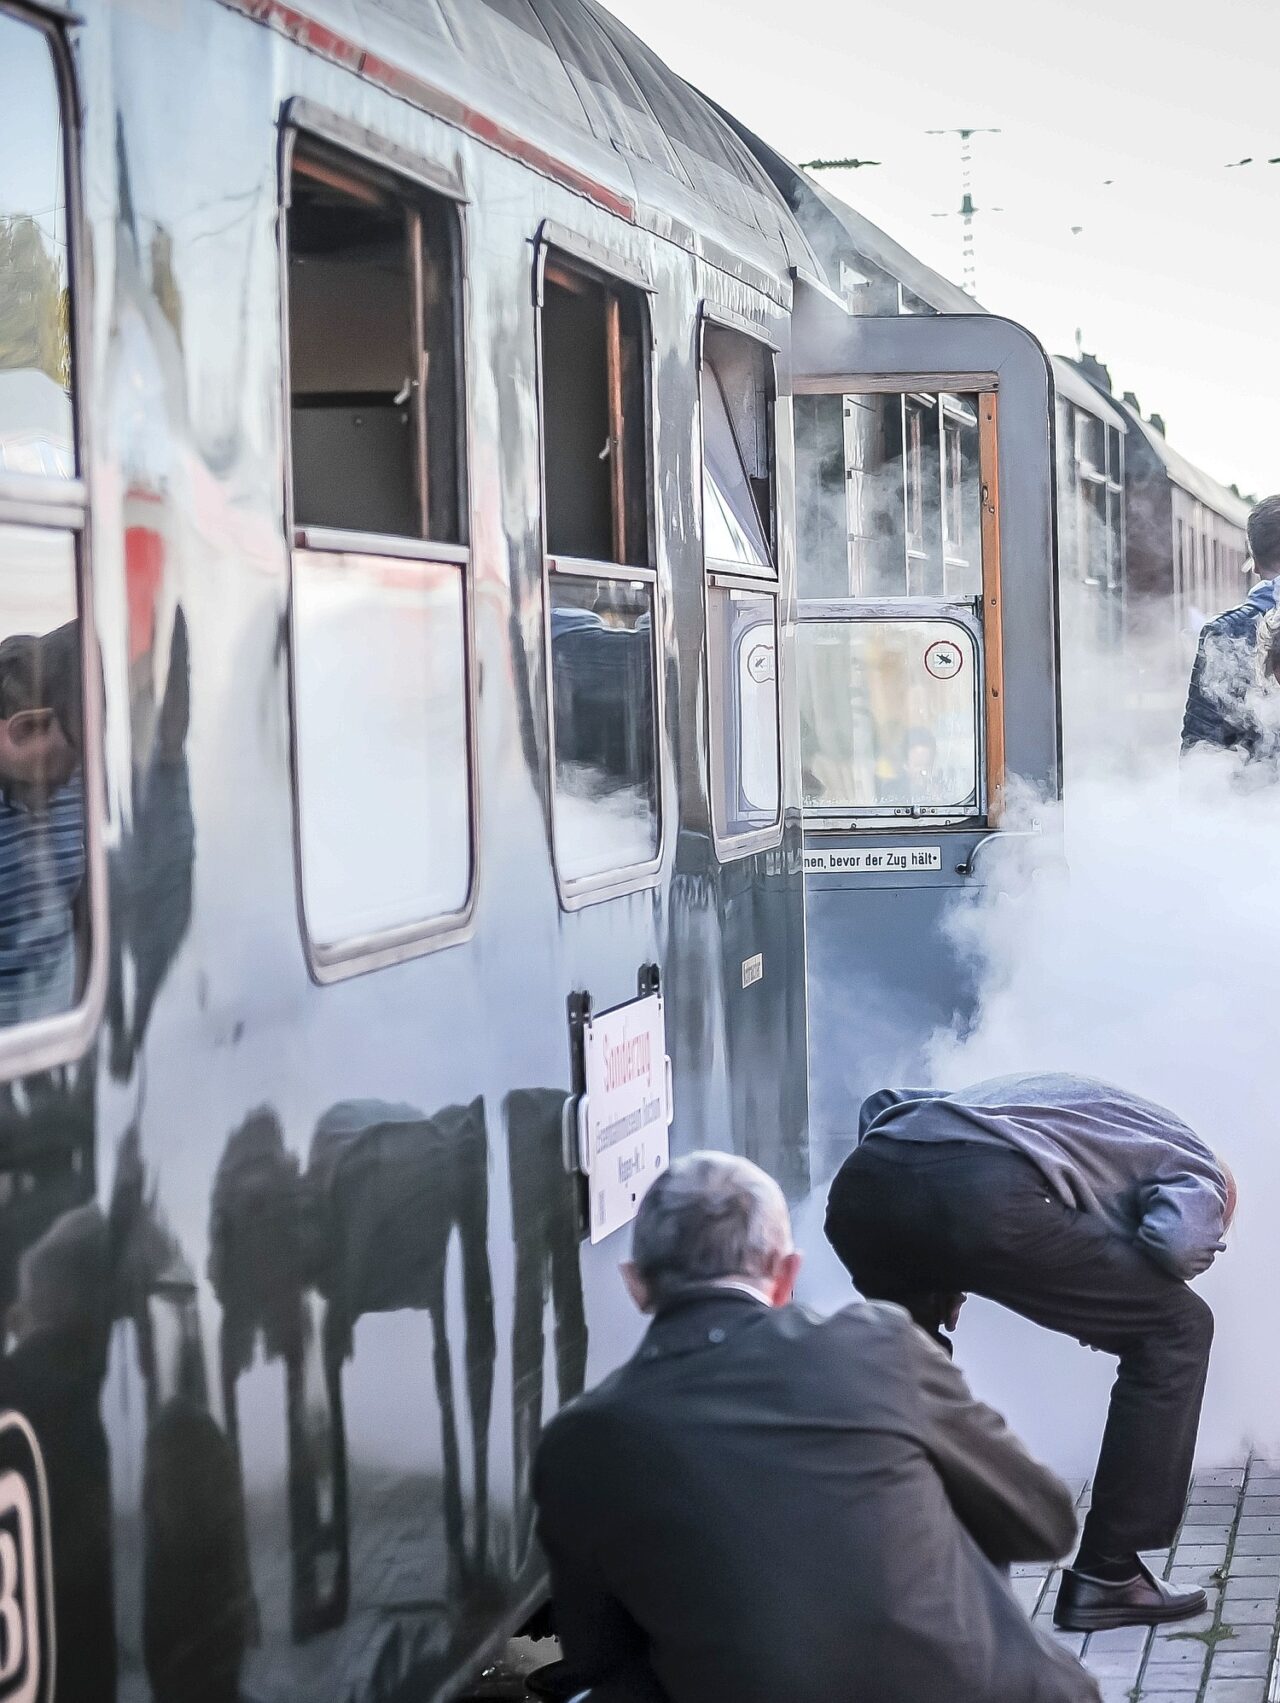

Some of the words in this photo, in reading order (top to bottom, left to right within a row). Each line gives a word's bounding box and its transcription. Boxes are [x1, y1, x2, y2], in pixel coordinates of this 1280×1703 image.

[829, 855, 860, 867] bevor
[865, 854, 883, 866] der
[886, 853, 907, 868] Zug
[603, 1026, 651, 1092] Sonderzug
